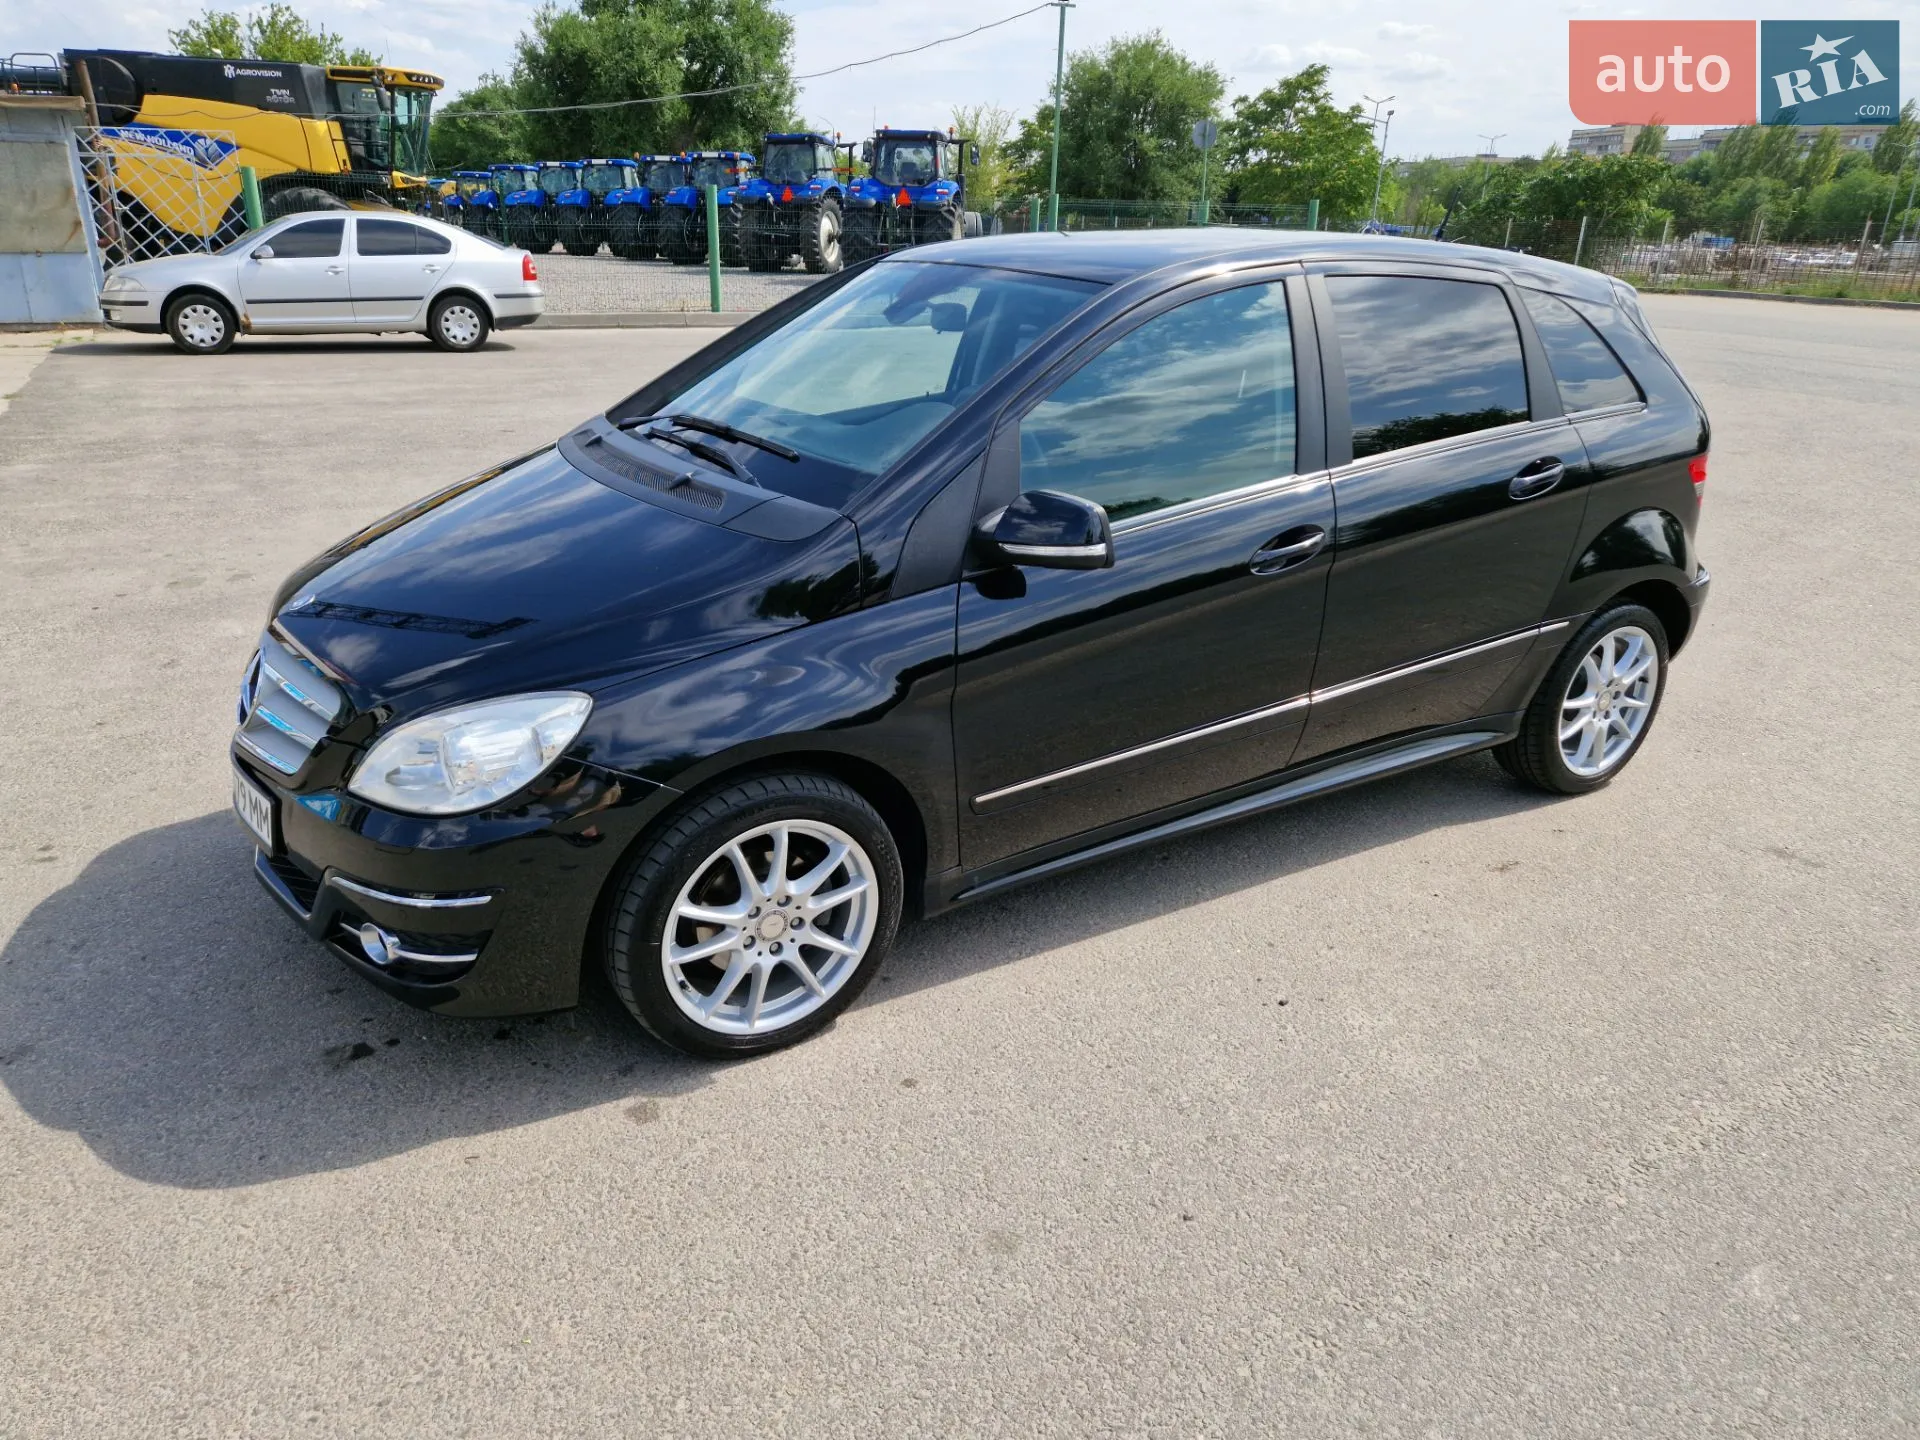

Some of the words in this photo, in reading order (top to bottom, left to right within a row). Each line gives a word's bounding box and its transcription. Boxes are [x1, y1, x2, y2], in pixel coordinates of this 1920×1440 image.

[236, 68, 282, 77] AGROVISION
[266, 95, 295, 104] ROTOR
[120, 129, 145, 142] NEW
[145, 134, 194, 156] HOLLAND
[248, 789, 270, 839] MM
